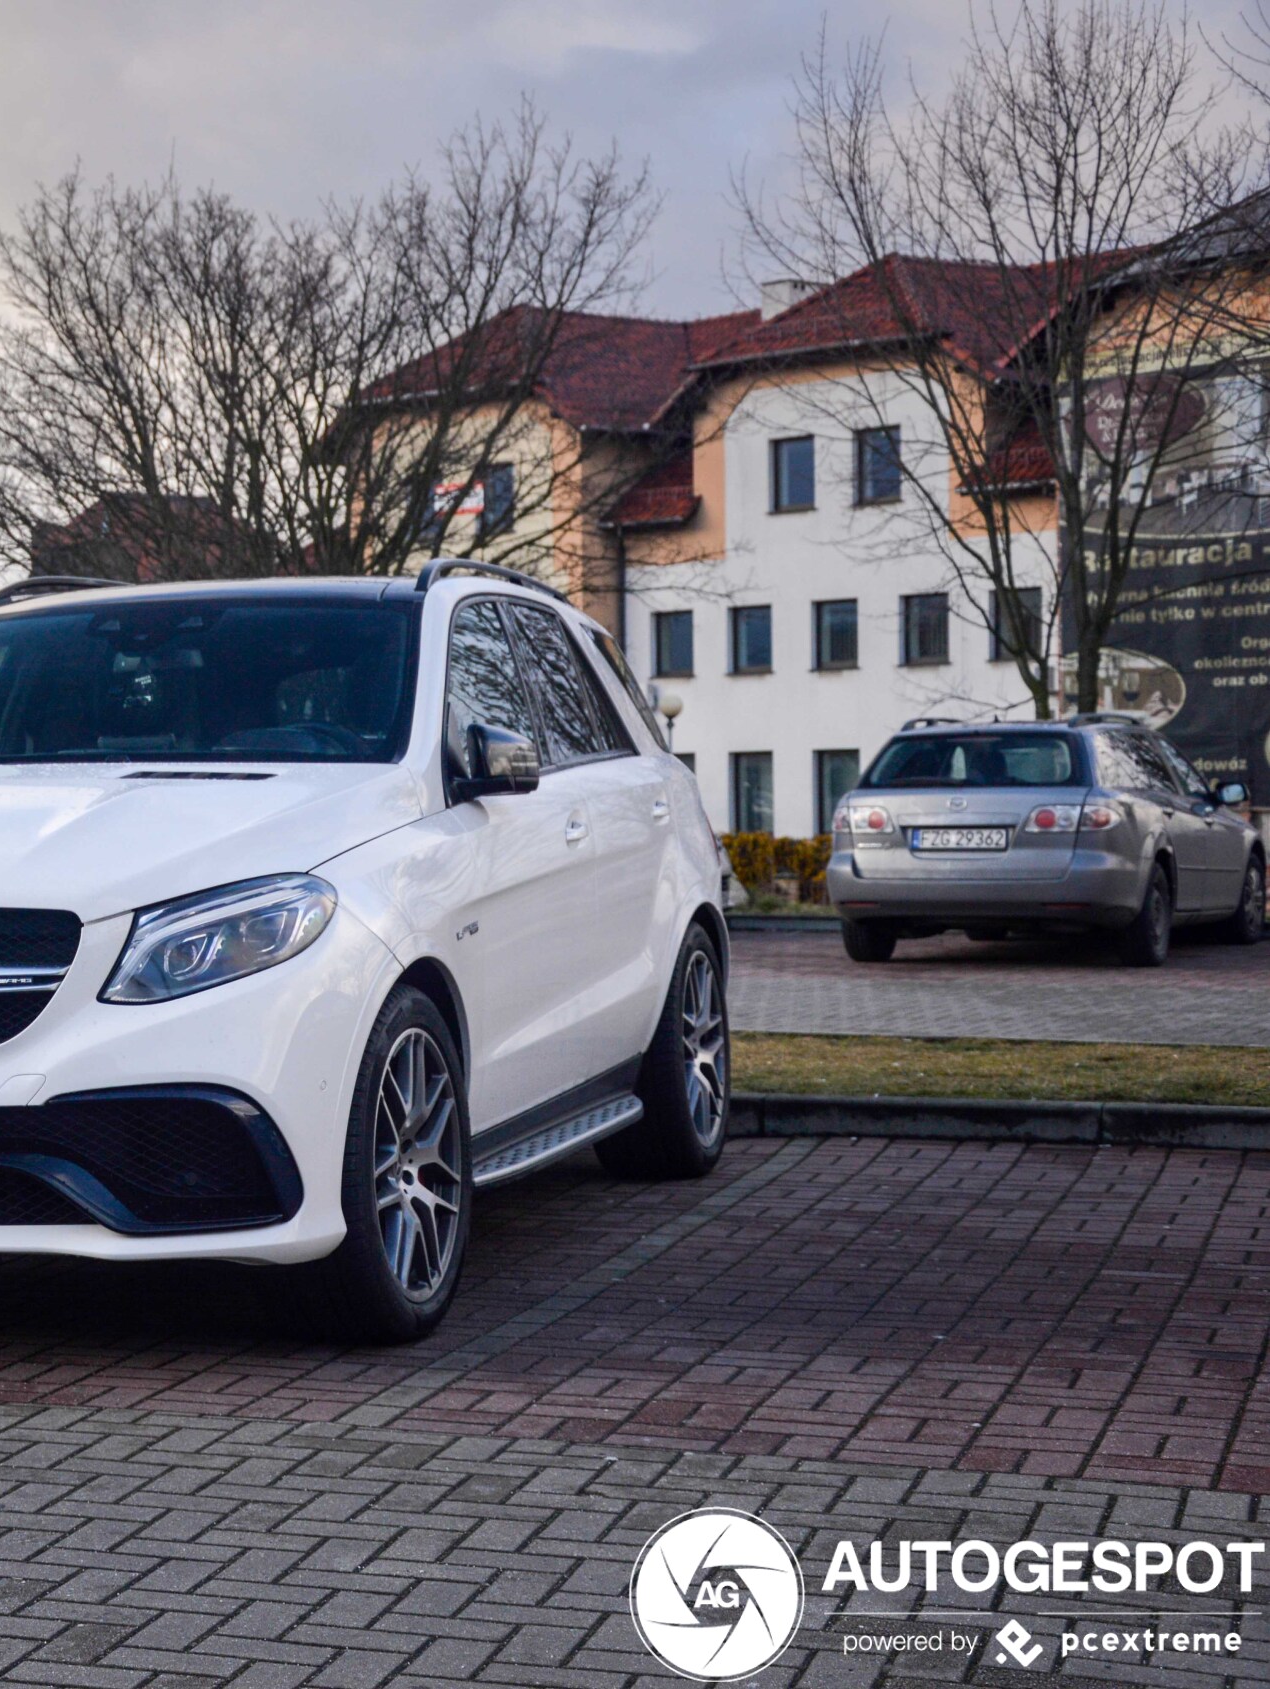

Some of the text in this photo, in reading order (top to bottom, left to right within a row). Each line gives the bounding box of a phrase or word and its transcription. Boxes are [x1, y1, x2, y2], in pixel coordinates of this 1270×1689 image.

[1082, 538, 1252, 573] Retauracja
[1151, 605, 1196, 624] tylko
[1201, 606, 1216, 618] w
[1241, 636, 1270, 650] Org
[1194, 655, 1270, 669] okoliczno
[1212, 676, 1245, 687] oraz
[955, 829, 1004, 847] 29362
